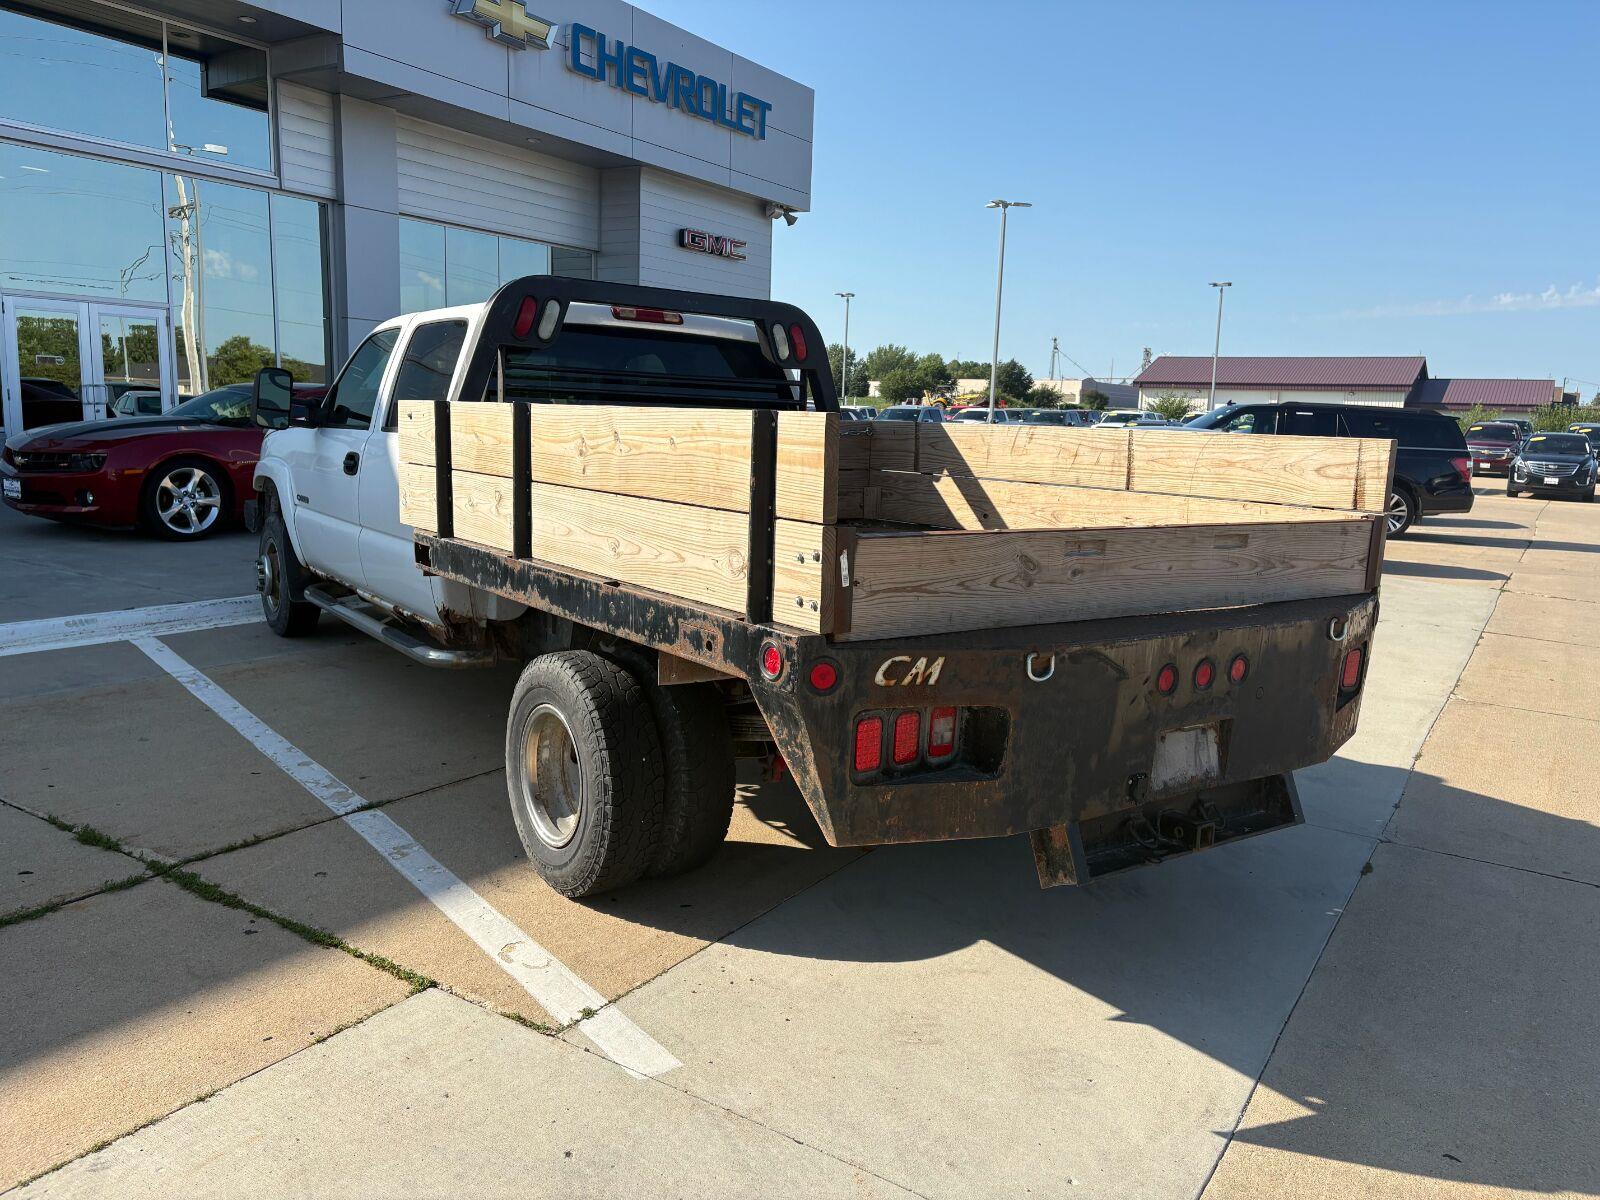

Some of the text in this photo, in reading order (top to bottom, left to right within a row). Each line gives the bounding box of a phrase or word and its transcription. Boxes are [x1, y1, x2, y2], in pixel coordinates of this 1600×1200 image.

[567, 23, 772, 140] CHEVROLET
[683, 228, 747, 260] GMC
[874, 655, 946, 687] CM
